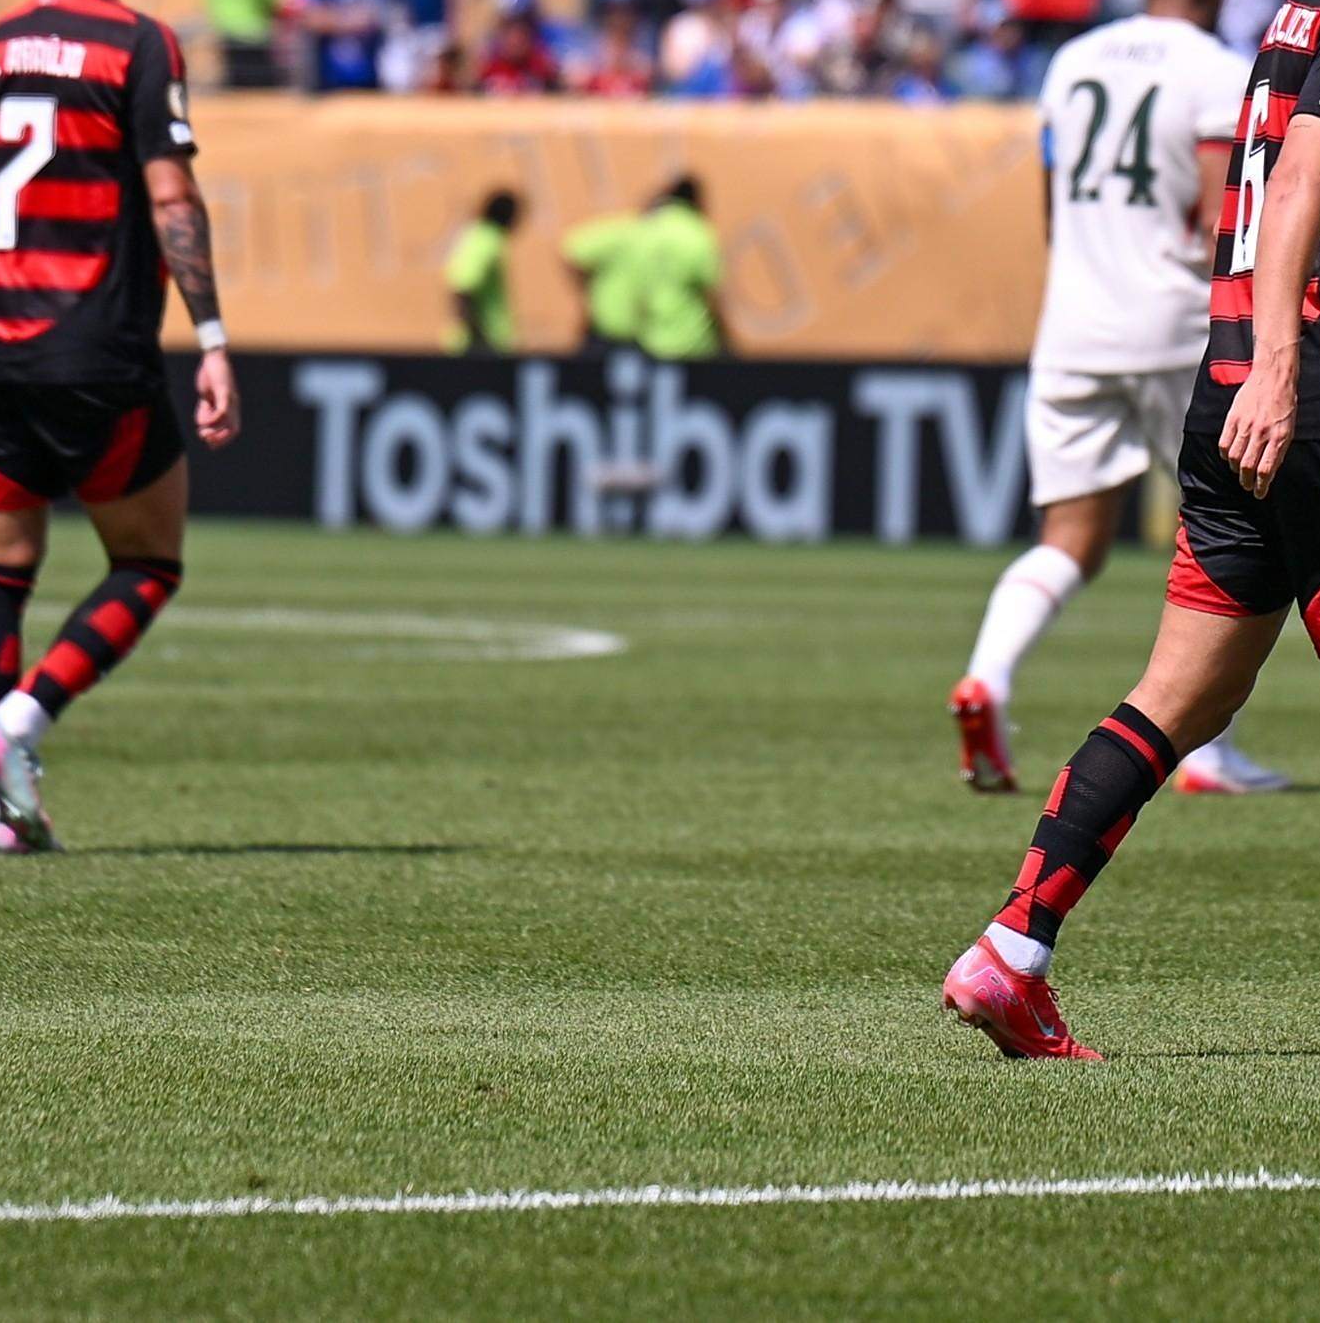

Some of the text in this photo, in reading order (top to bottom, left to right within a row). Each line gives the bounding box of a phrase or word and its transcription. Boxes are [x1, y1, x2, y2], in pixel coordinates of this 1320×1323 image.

[1068, 78, 1158, 206] 24
[292, 354, 834, 541] Toshiba
[853, 374, 1030, 546] TV
